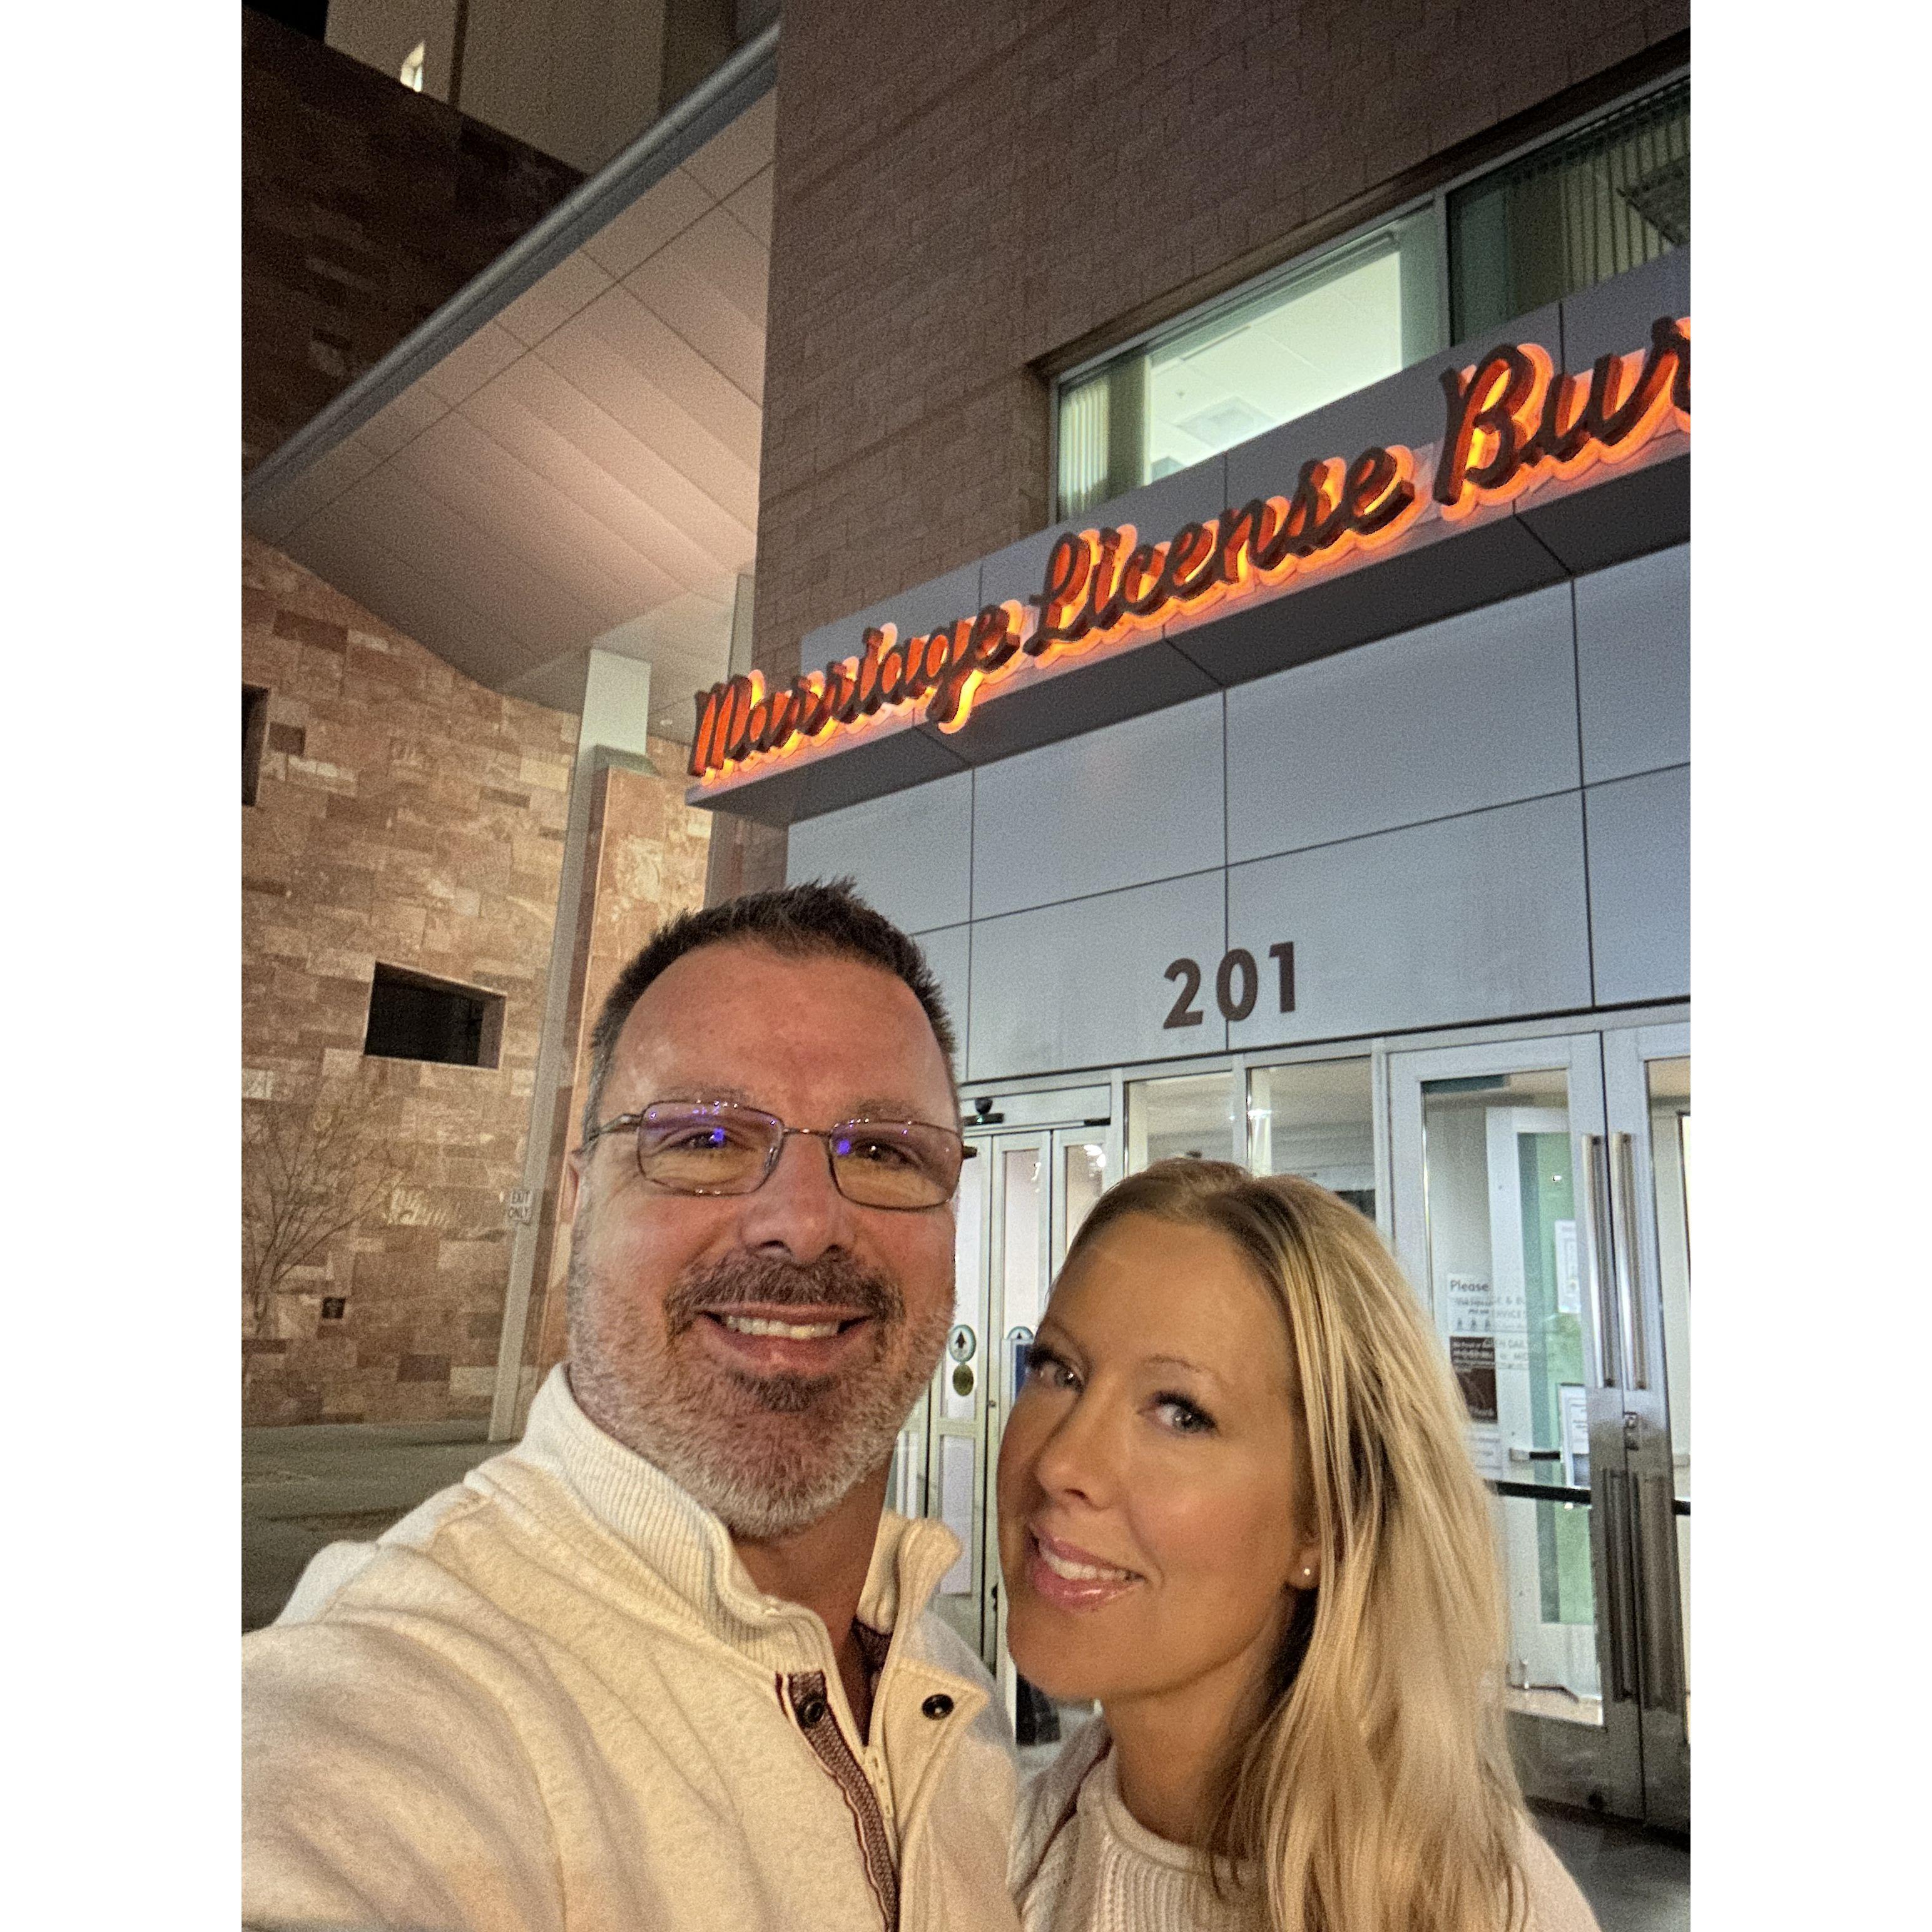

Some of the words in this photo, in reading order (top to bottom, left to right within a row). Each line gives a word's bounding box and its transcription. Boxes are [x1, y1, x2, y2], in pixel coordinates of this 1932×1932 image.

[688, 604, 1020, 777] Marriage
[1024, 446, 1415, 657] License
[1163, 941, 1296, 1029] 201
[511, 1191, 531, 1204] EXIT
[509, 1206, 530, 1219] ONLY
[1450, 1279, 1490, 1292] Please
